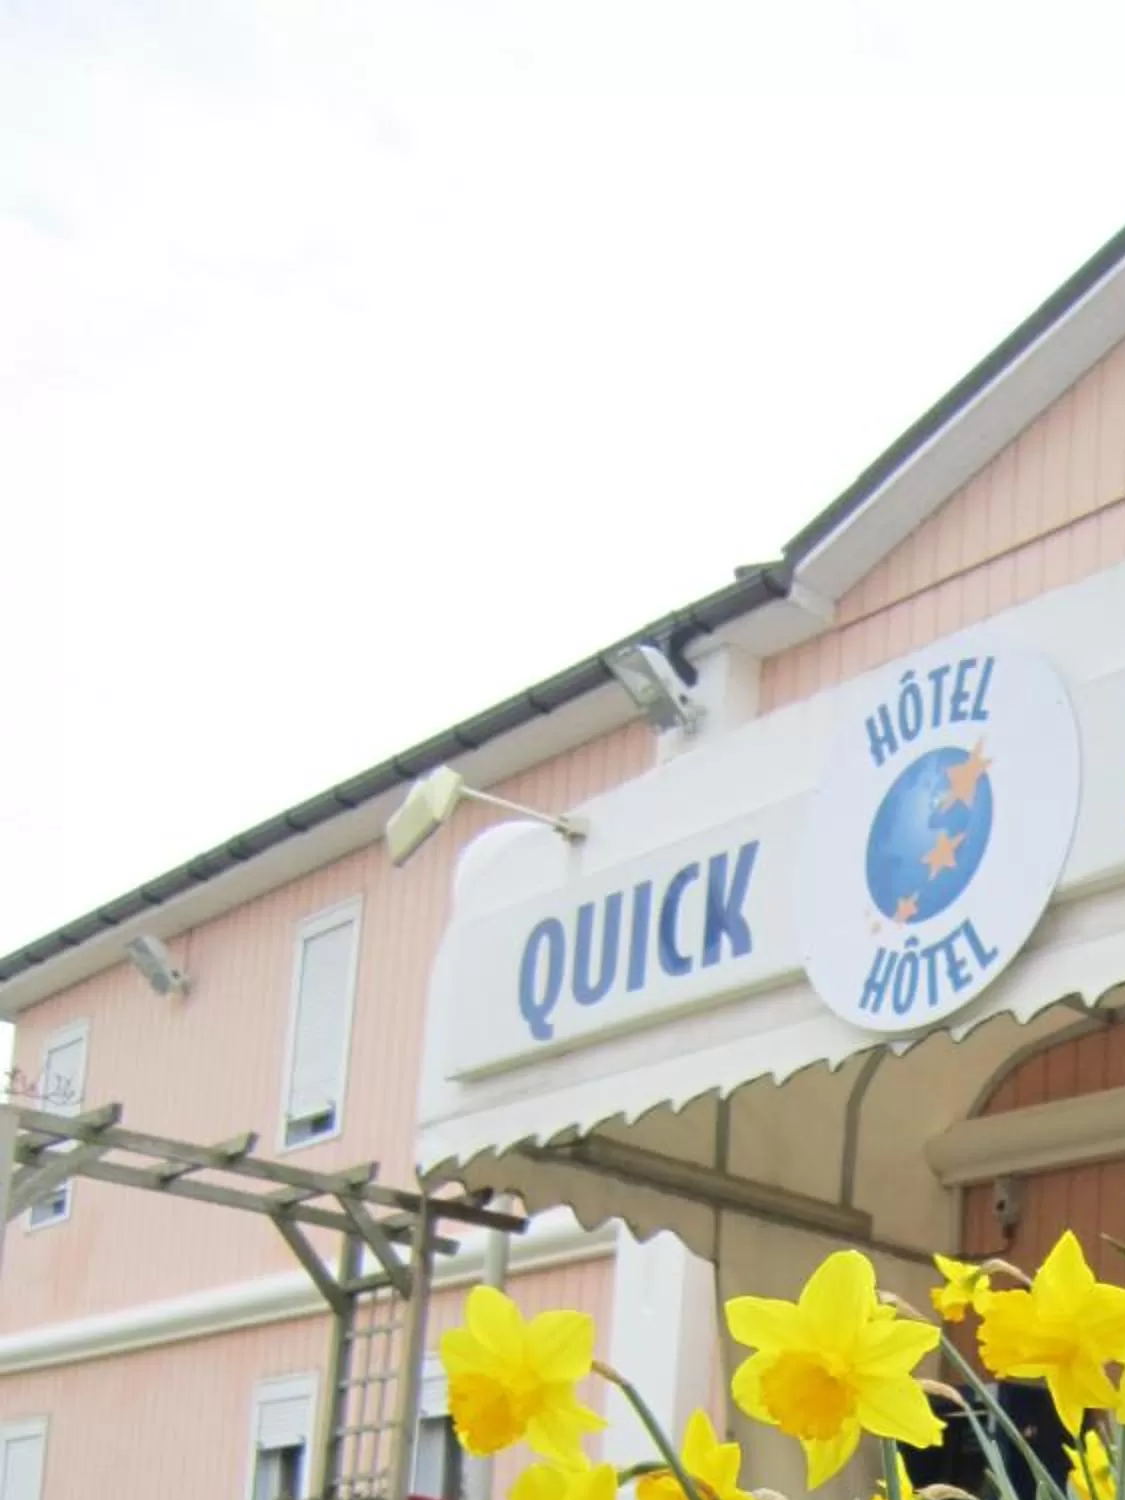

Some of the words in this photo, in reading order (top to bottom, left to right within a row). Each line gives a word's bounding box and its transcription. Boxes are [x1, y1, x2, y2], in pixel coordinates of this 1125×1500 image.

[864, 655, 995, 768] HÔTEL
[517, 840, 760, 1041] QUICK
[858, 917, 999, 1016] HÔTEL
